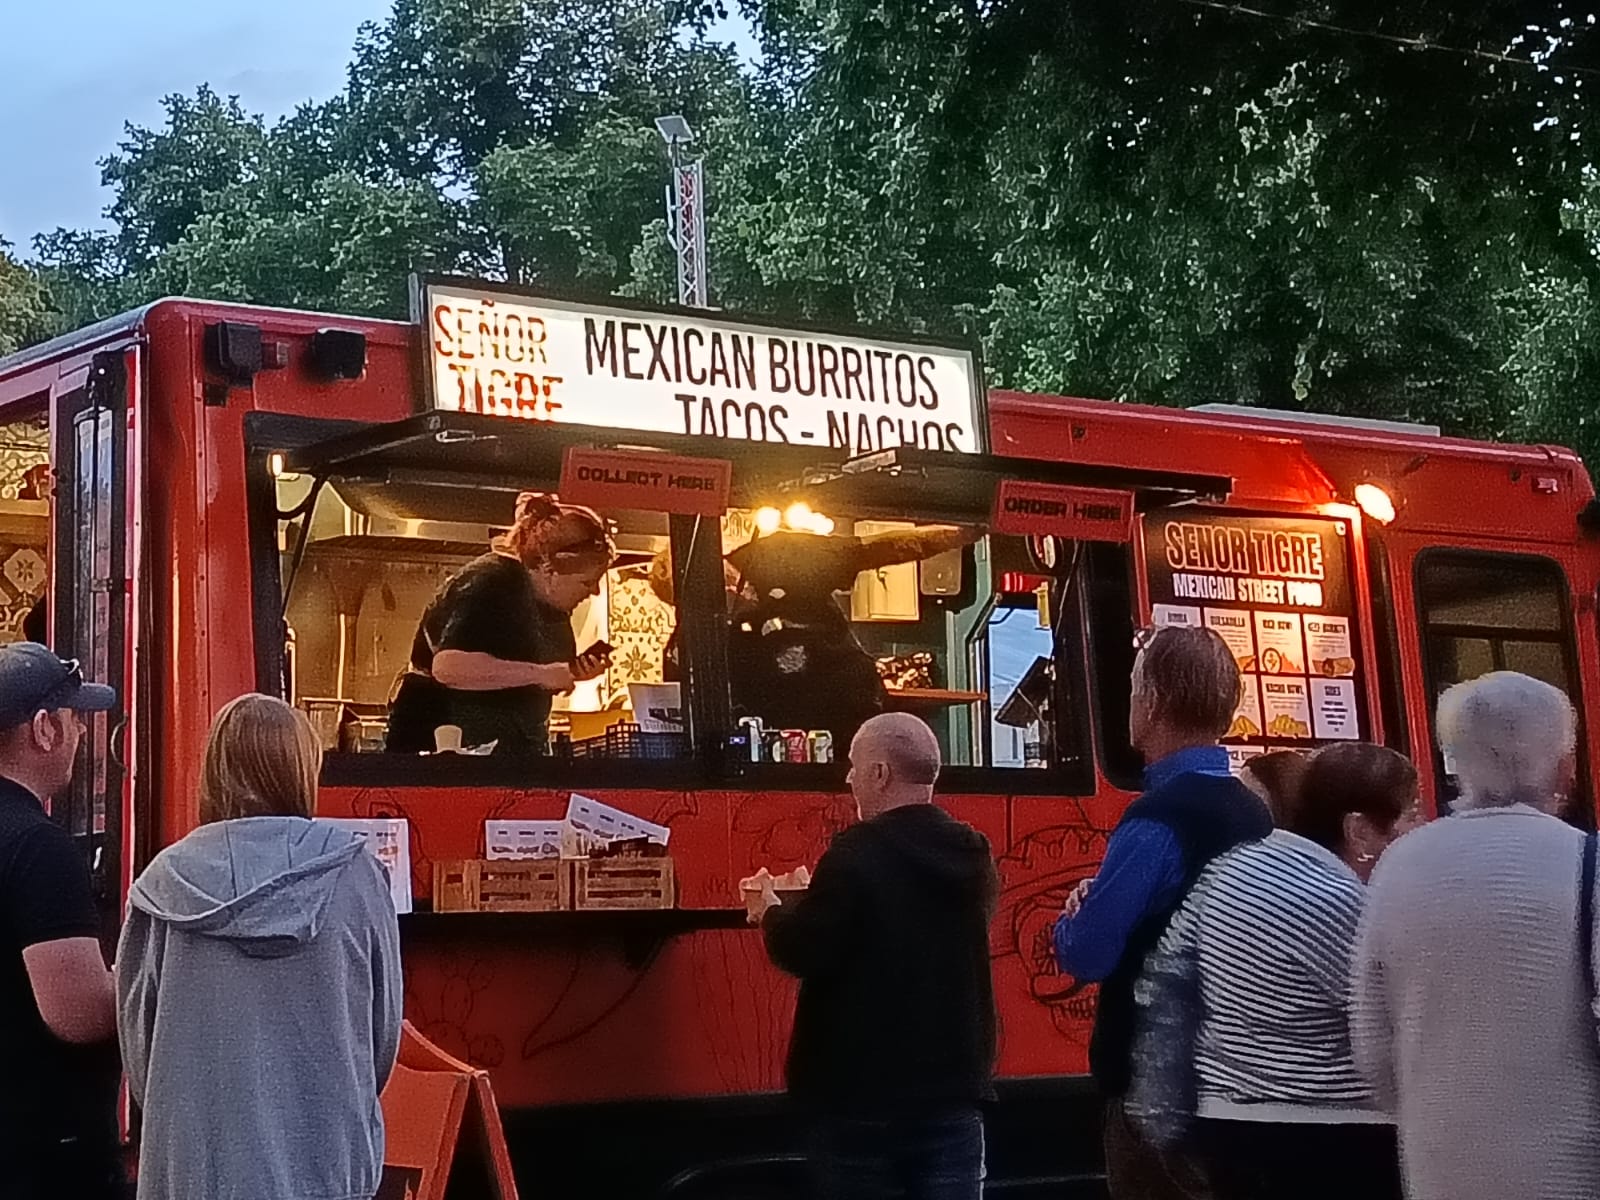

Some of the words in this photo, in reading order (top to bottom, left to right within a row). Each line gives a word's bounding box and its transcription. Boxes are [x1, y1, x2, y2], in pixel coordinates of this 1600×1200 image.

[434, 299, 546, 364] SEÑOR
[584, 318, 756, 391] MEXICAN
[768, 338, 939, 410] BURRITOS
[675, 394, 789, 443] TACOS
[826, 410, 963, 453] NACHOS
[577, 466, 663, 488] COLLECT
[668, 473, 716, 491] HERE
[1004, 497, 1068, 517] ORDER
[1073, 503, 1122, 521] HERE
[1250, 529, 1324, 580] TIGRE
[1172, 572, 1236, 601] MEXICAN
[1237, 577, 1285, 604] STREET
